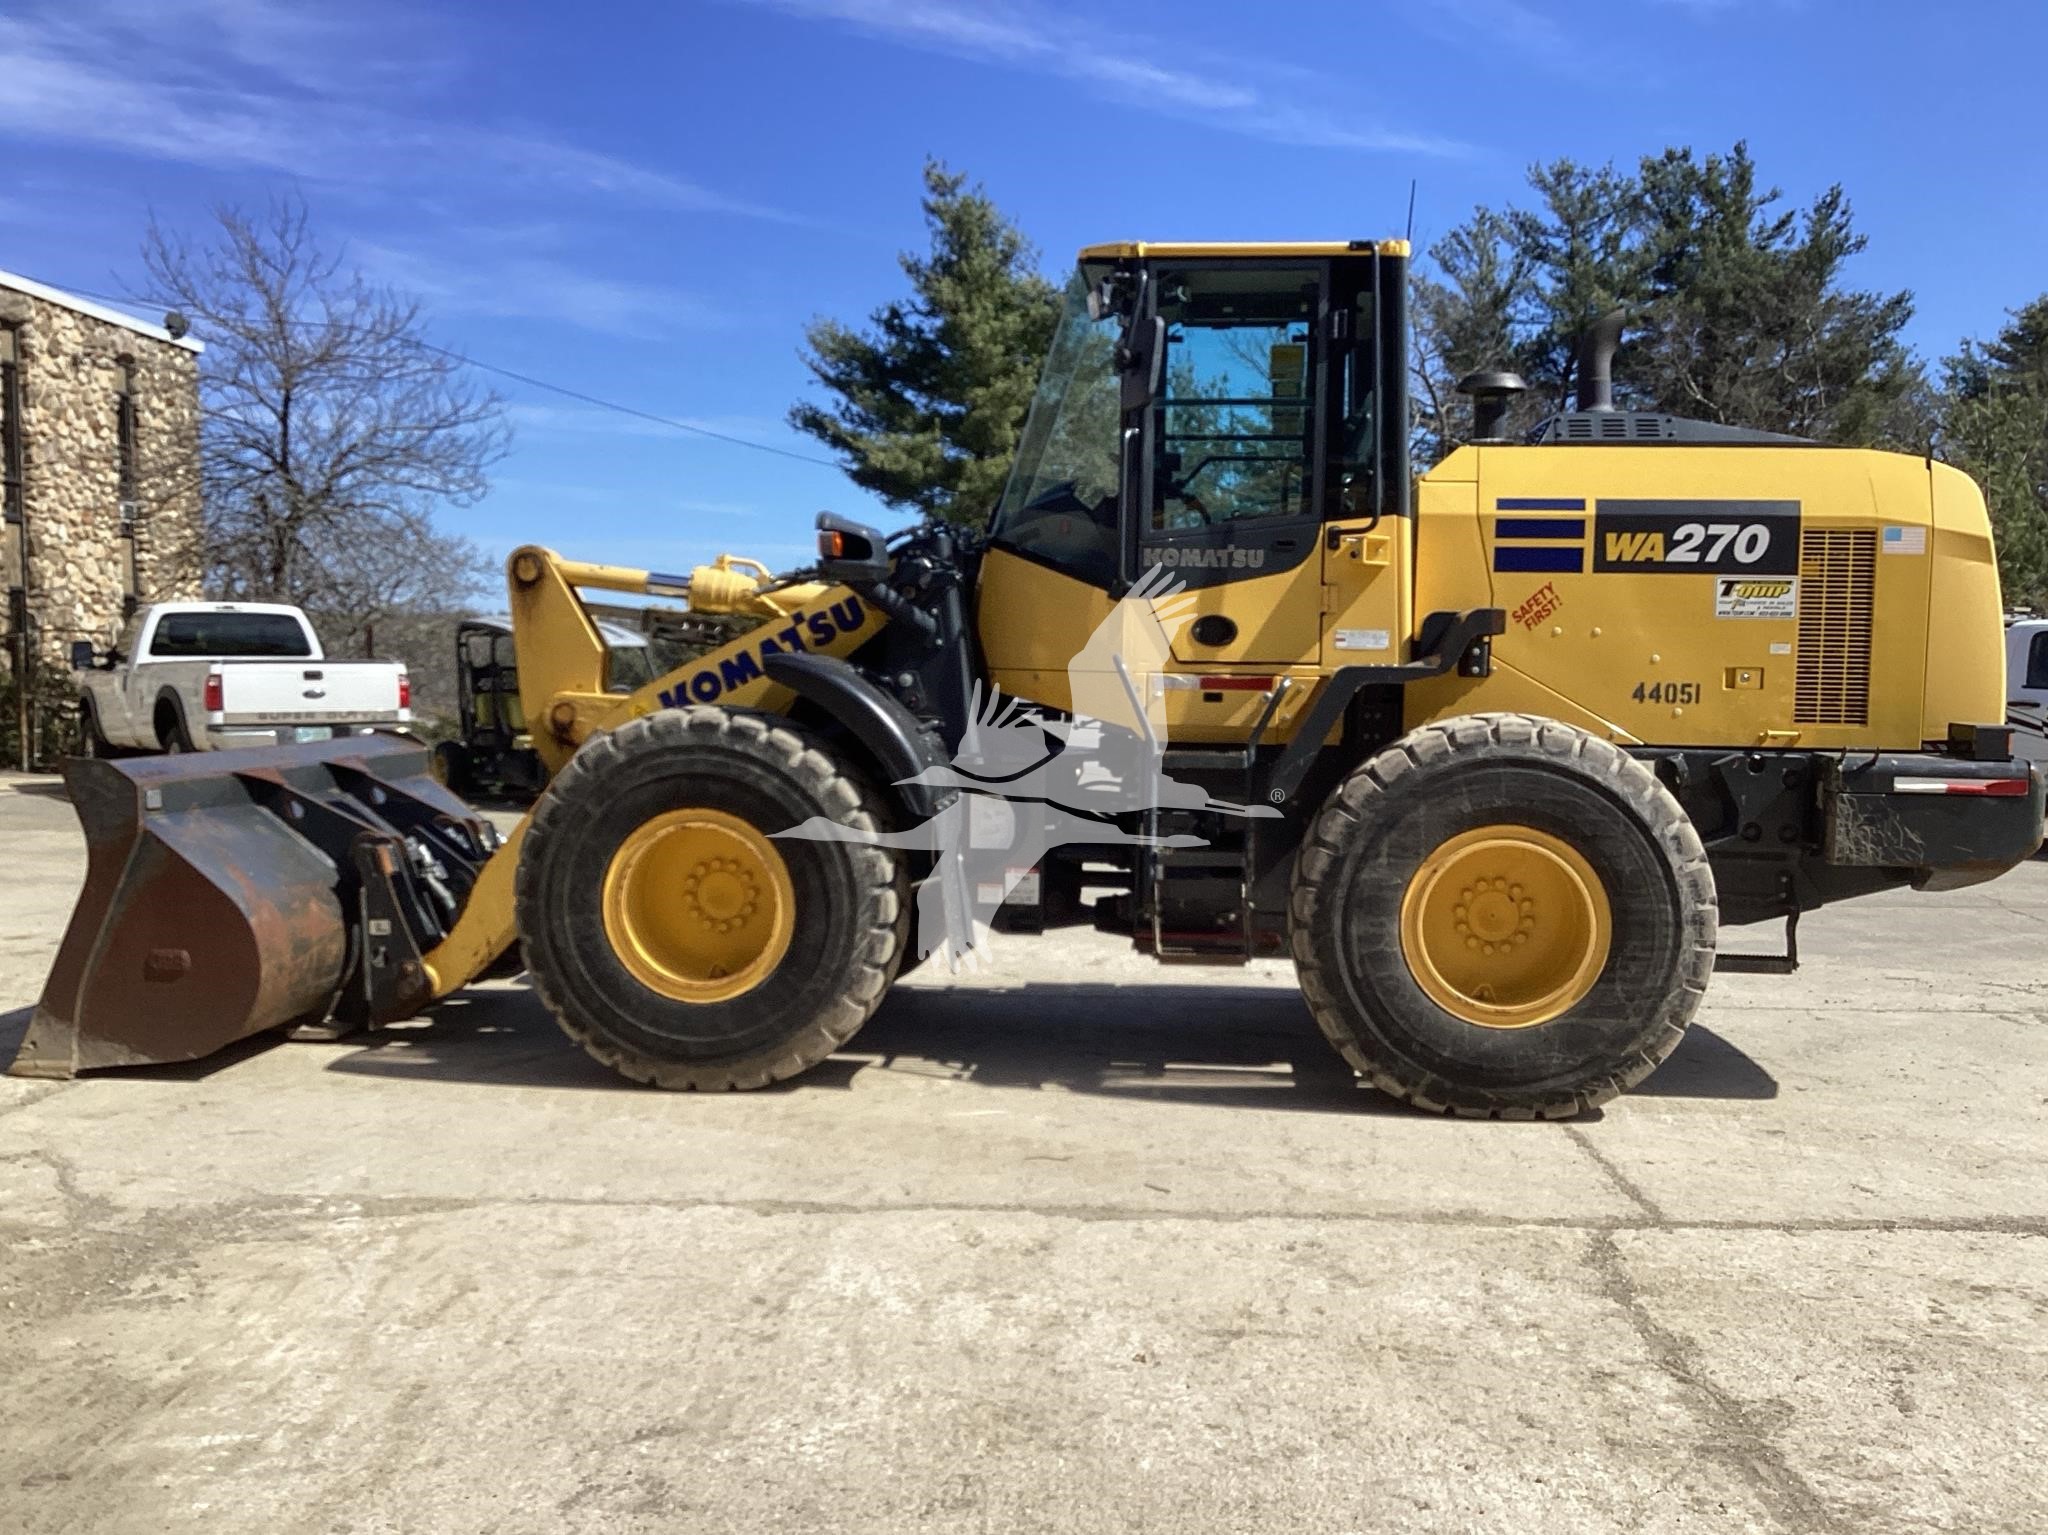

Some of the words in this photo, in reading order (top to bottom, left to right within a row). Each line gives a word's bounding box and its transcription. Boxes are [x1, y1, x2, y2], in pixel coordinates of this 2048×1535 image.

[1142, 544, 1265, 568] KOMATSU
[1512, 581, 1555, 623] SAFETY
[1524, 594, 1563, 632] FIRST!
[1632, 682, 1702, 705] 44051
[257, 711, 316, 720] SUPER
[326, 710, 370, 720] DUTY
